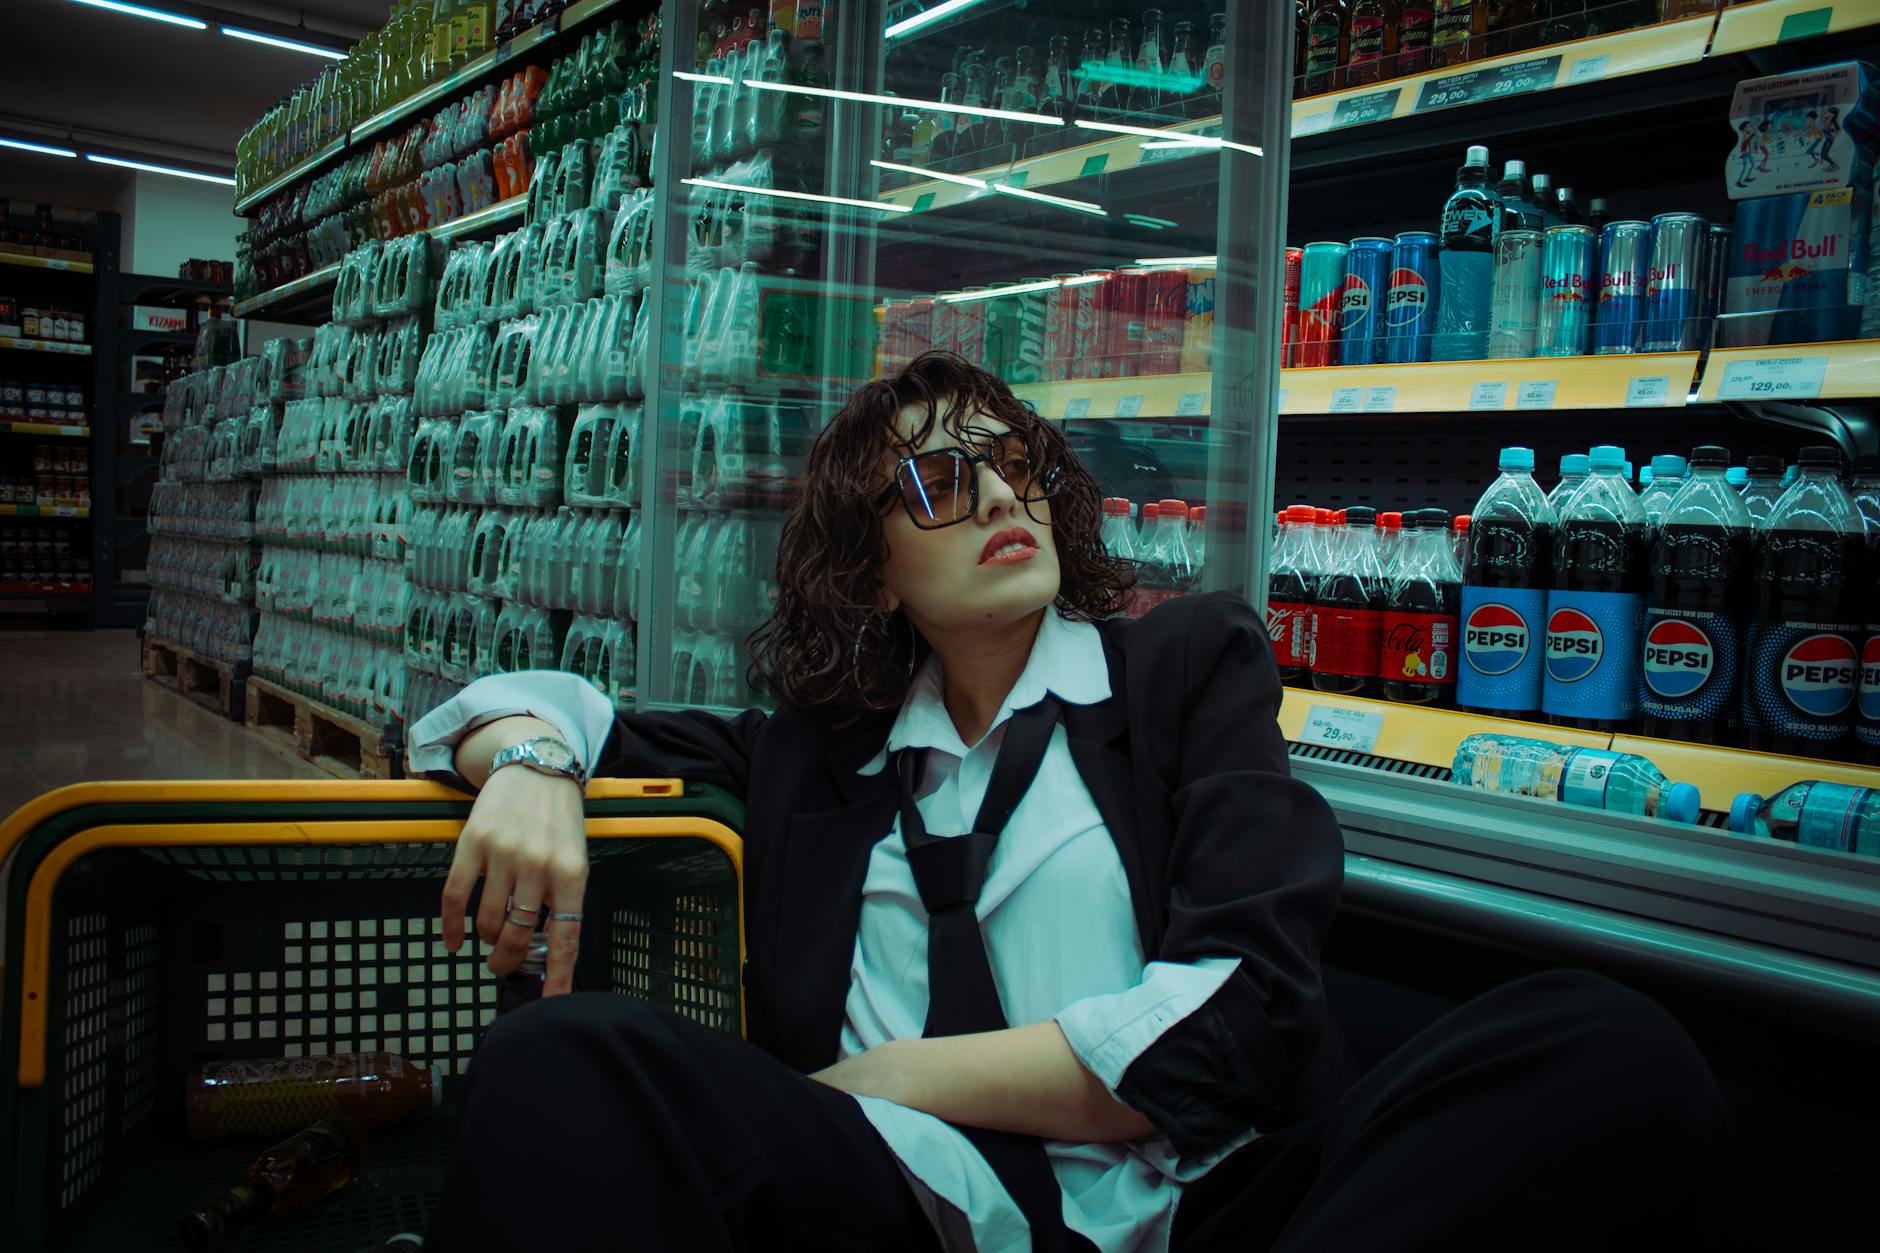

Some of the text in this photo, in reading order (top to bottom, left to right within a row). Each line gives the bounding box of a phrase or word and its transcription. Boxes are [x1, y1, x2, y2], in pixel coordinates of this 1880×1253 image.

[1815, 194, 1824, 206] 4
[1744, 234, 1837, 264] Red Bull
[1542, 273, 1569, 289] Red
[1602, 271, 1631, 288] Bull
[1388, 291, 1425, 305] EPSI
[1467, 630, 1525, 649] PEPSI
[1547, 635, 1598, 655] PEPSI
[1645, 647, 1709, 669] PEPSI
[1786, 664, 1857, 685] PEPSI
[1643, 701, 1701, 715] ZERO SUGAR
[1785, 721, 1816, 732] ZERO
